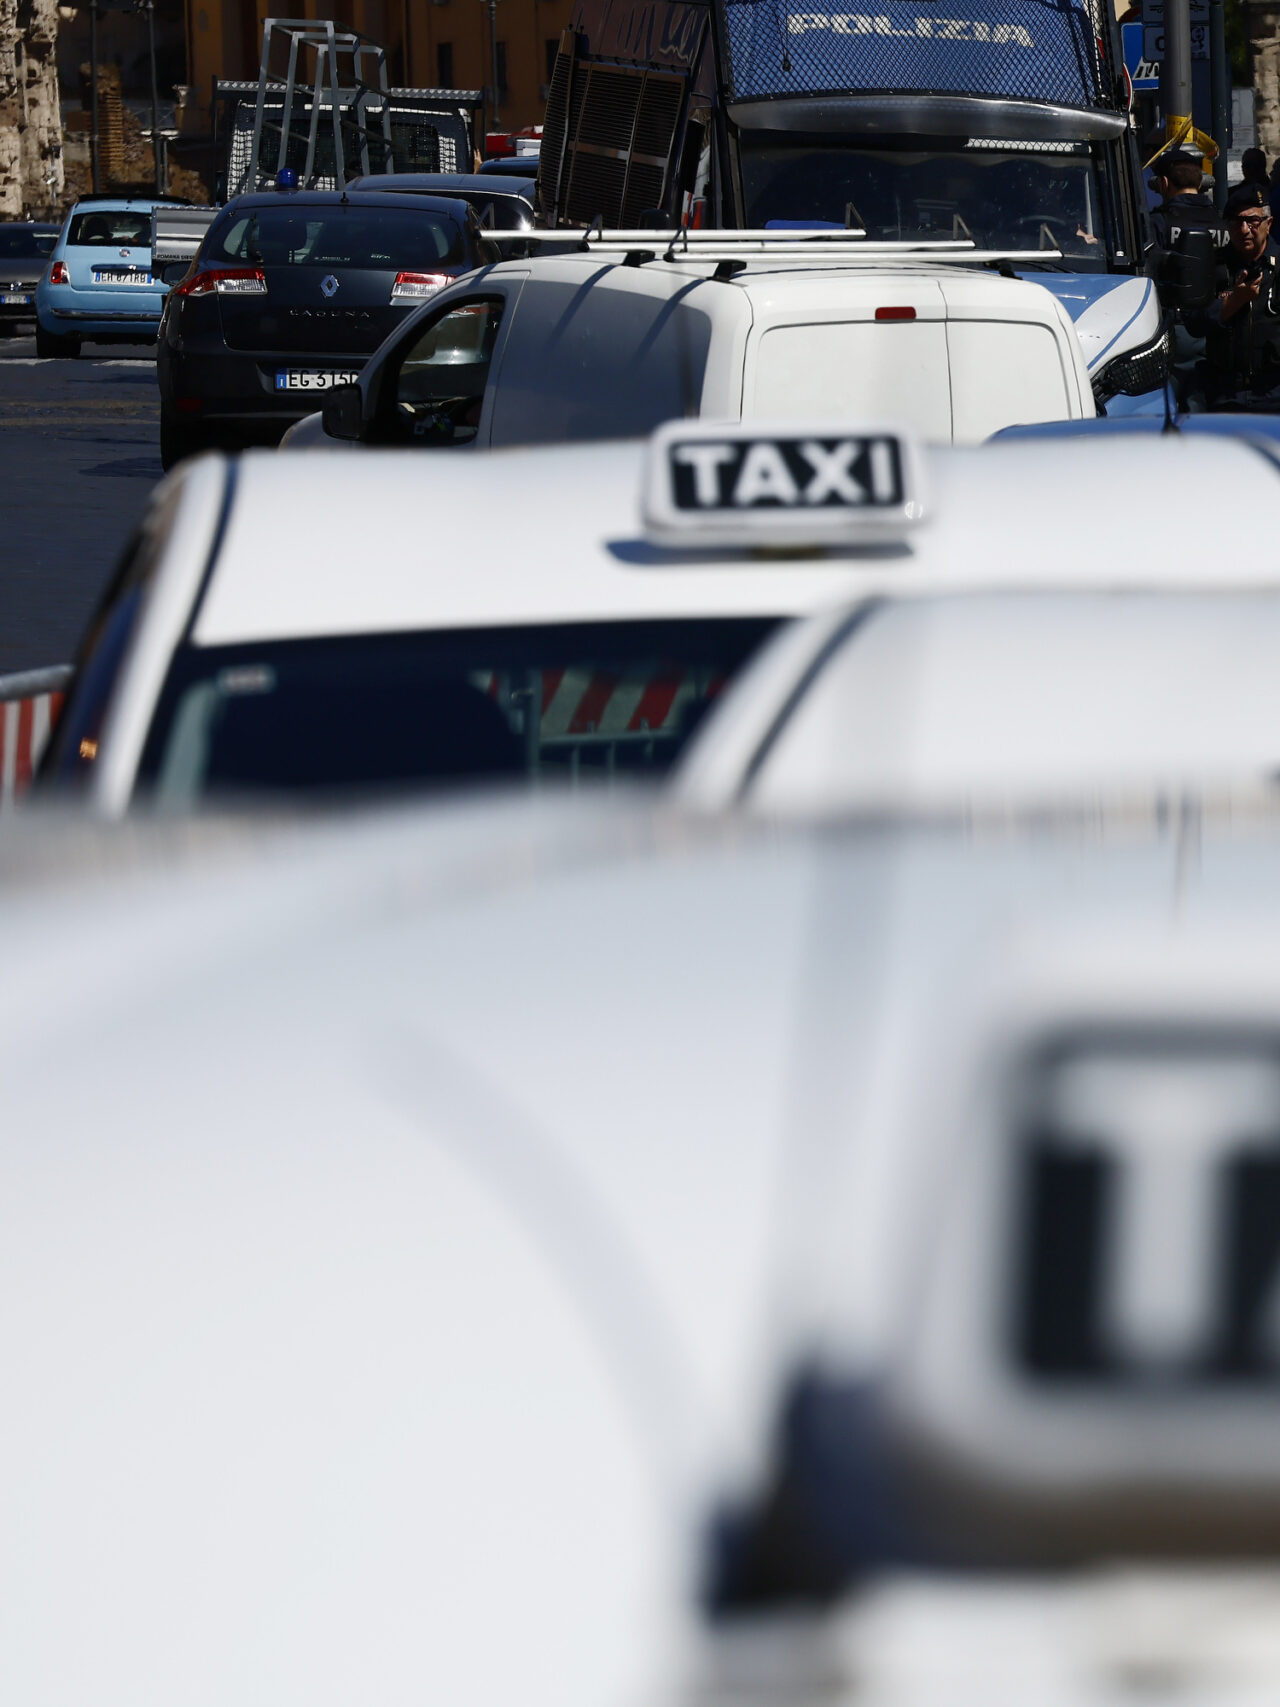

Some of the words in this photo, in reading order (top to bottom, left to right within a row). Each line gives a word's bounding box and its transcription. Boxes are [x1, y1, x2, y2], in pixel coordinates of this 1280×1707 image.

[787, 13, 1035, 48] POLIZIA
[1171, 226, 1231, 247] PZIA
[290, 369, 310, 387] EG
[675, 440, 895, 506] TAXI
